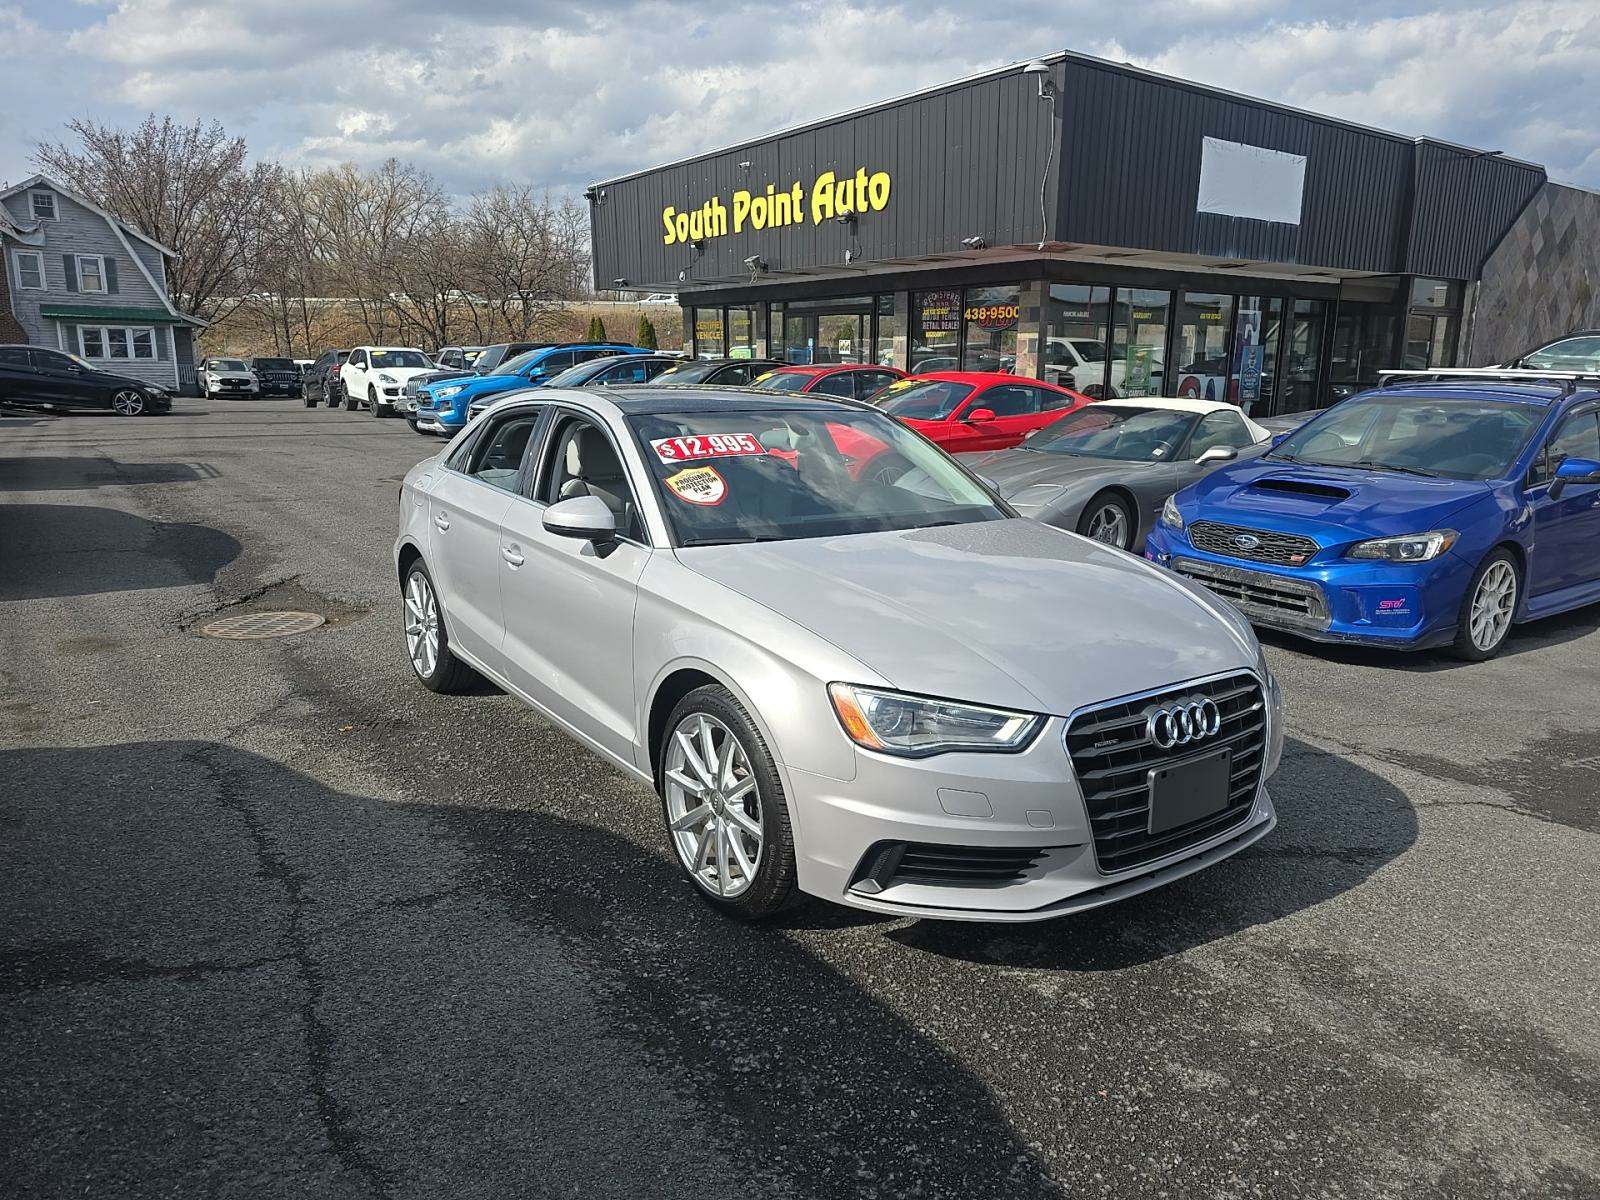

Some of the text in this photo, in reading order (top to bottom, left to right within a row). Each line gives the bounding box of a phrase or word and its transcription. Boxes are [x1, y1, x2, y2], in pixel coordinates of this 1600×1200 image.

[662, 166, 892, 245] South Point Auto
[660, 435, 756, 457] $12,995
[674, 471, 712, 487] PROGUARD
[676, 476, 719, 492] PROTECTION
[693, 484, 712, 493] PLAN
